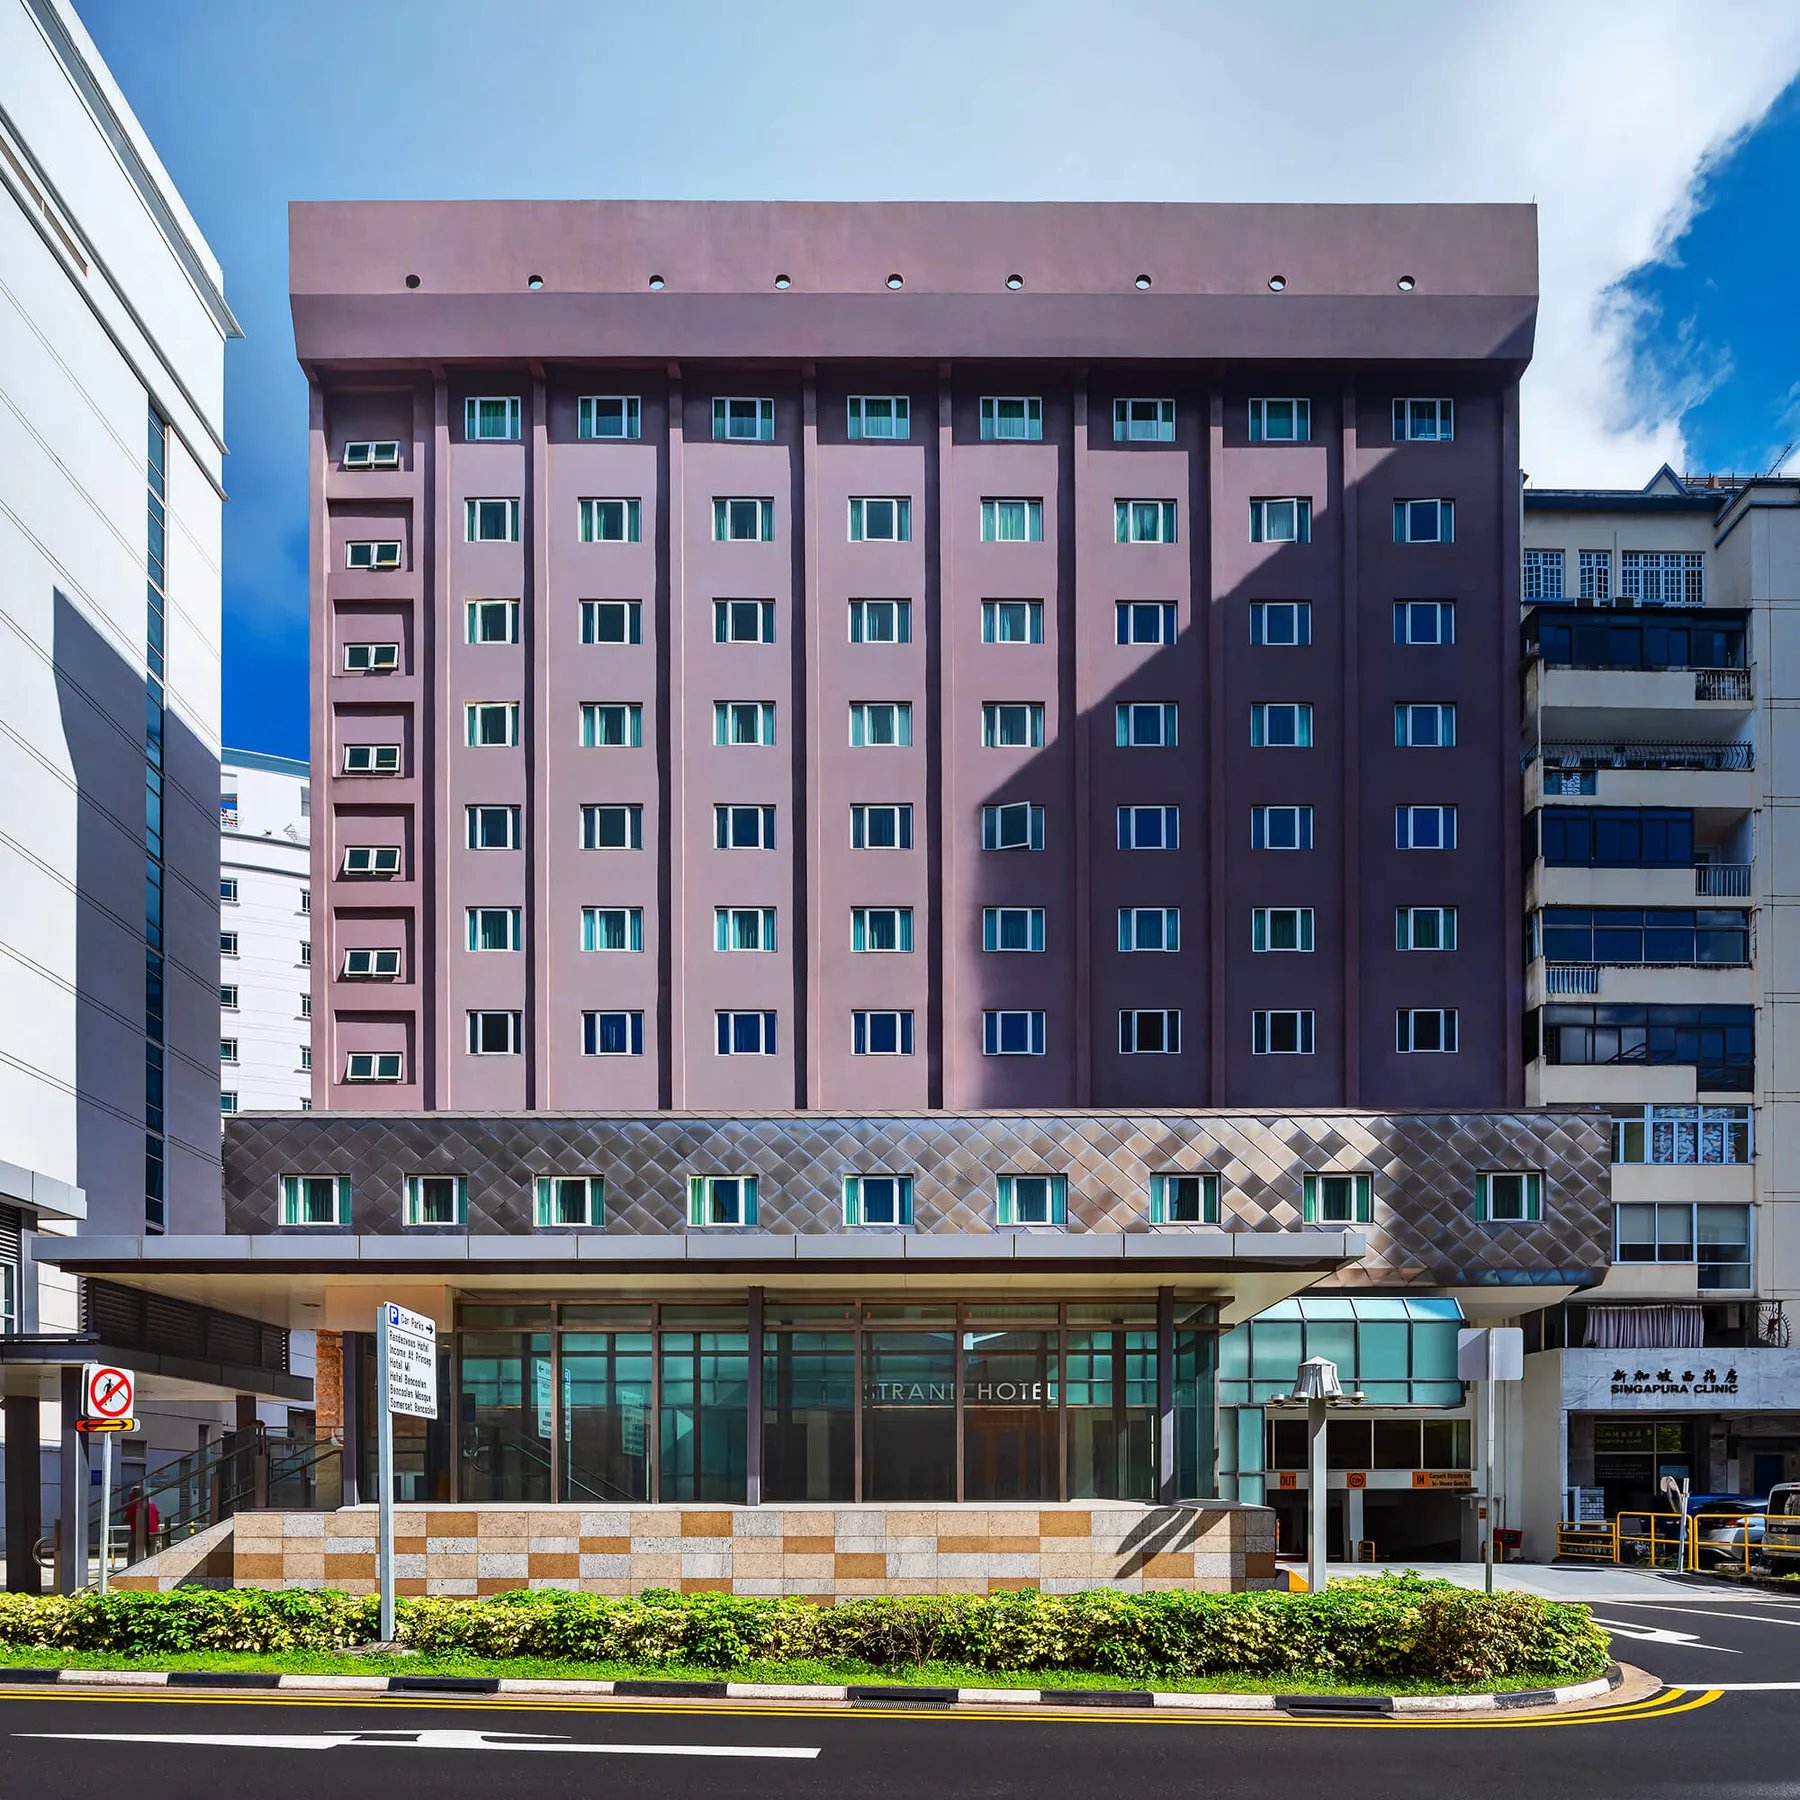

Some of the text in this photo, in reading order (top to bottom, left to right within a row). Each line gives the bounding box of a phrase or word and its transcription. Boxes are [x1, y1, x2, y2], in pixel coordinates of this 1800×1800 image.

[401, 1313, 410, 1325] Car
[411, 1317, 424, 1331] Parks
[389, 1330, 430, 1352] Rendezvous Hotel
[389, 1343, 406, 1358] Income
[415, 1351, 432, 1368] Prinsep
[389, 1356, 403, 1370] Hotel
[389, 1370, 427, 1389] Hotel Bencoolen
[389, 1383, 432, 1404] Bencoolen Mosque
[978, 1382, 1057, 1400] HOTEL
[1610, 1384, 1739, 1394] SINGAPURA CLINIC
[389, 1397, 436, 1415] Somerset Bencoolen
[1280, 1475, 1296, 1486] OUT
[1416, 1474, 1425, 1485] IN
